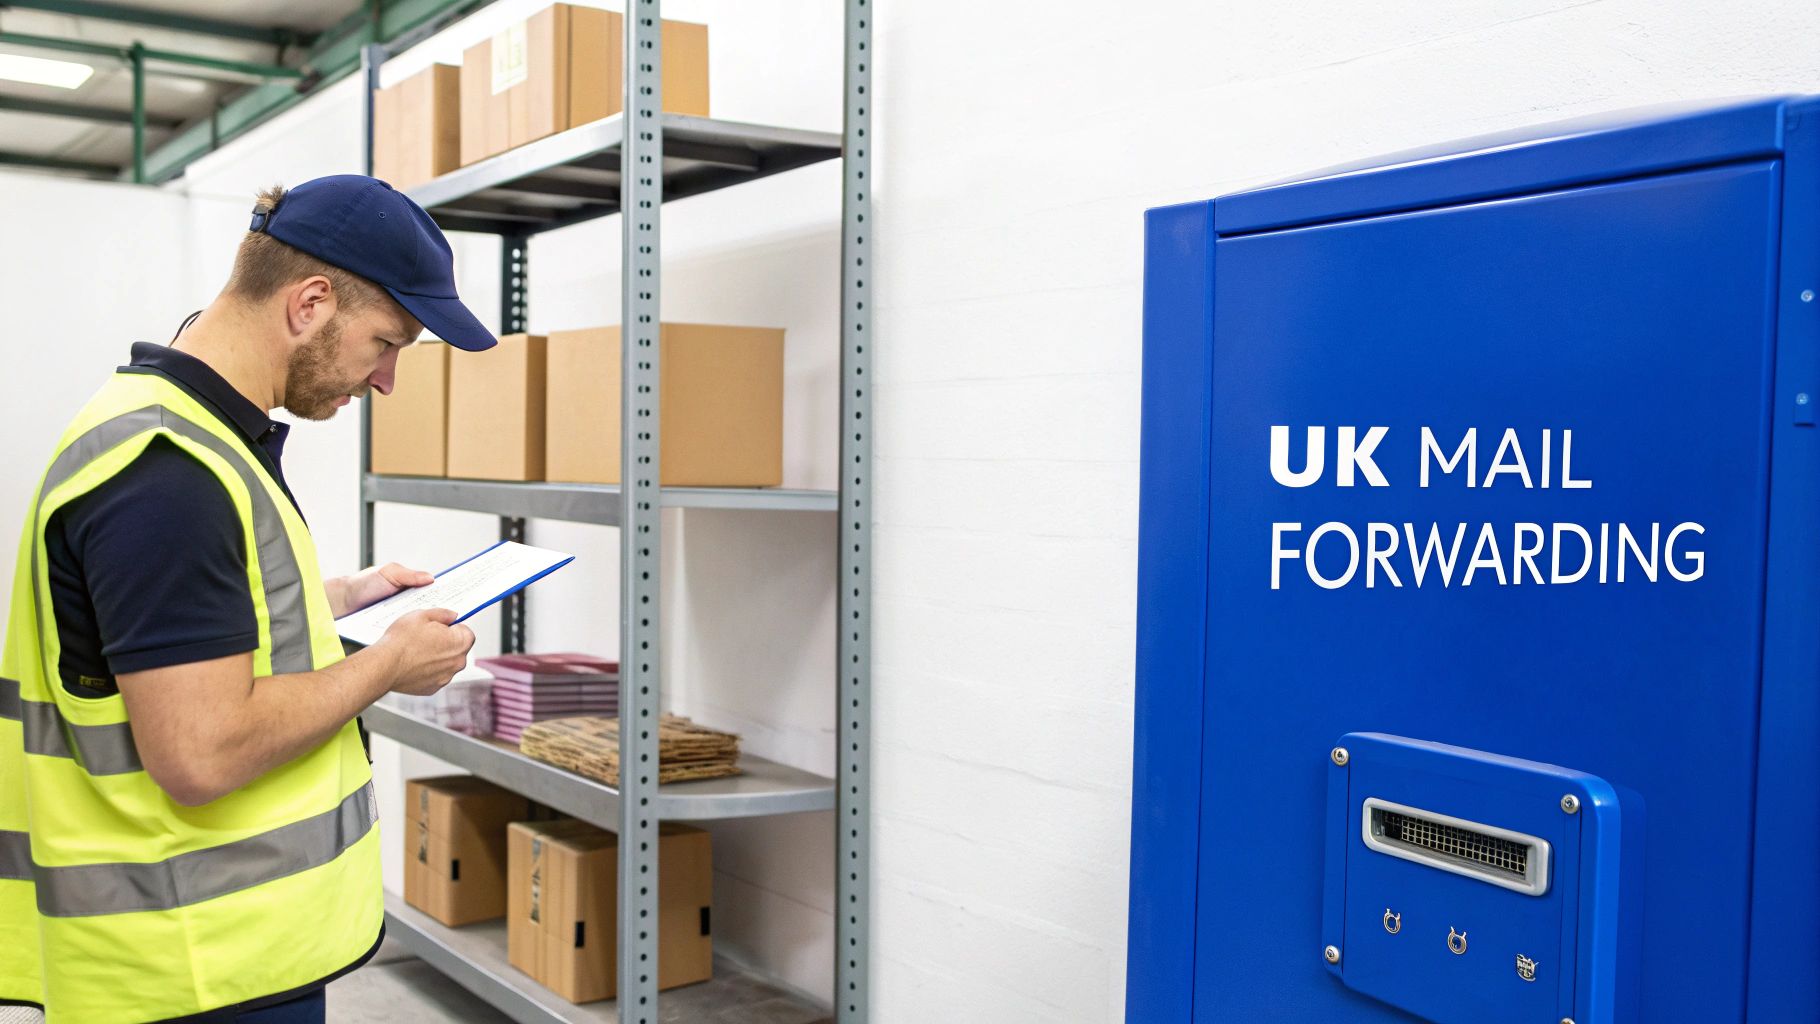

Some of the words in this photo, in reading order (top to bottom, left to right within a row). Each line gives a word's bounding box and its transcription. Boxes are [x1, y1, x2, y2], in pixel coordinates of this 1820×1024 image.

[1270, 426, 1390, 487] UK
[1420, 427, 1592, 488] MAIL
[1271, 522, 1705, 589] FORWARDING
